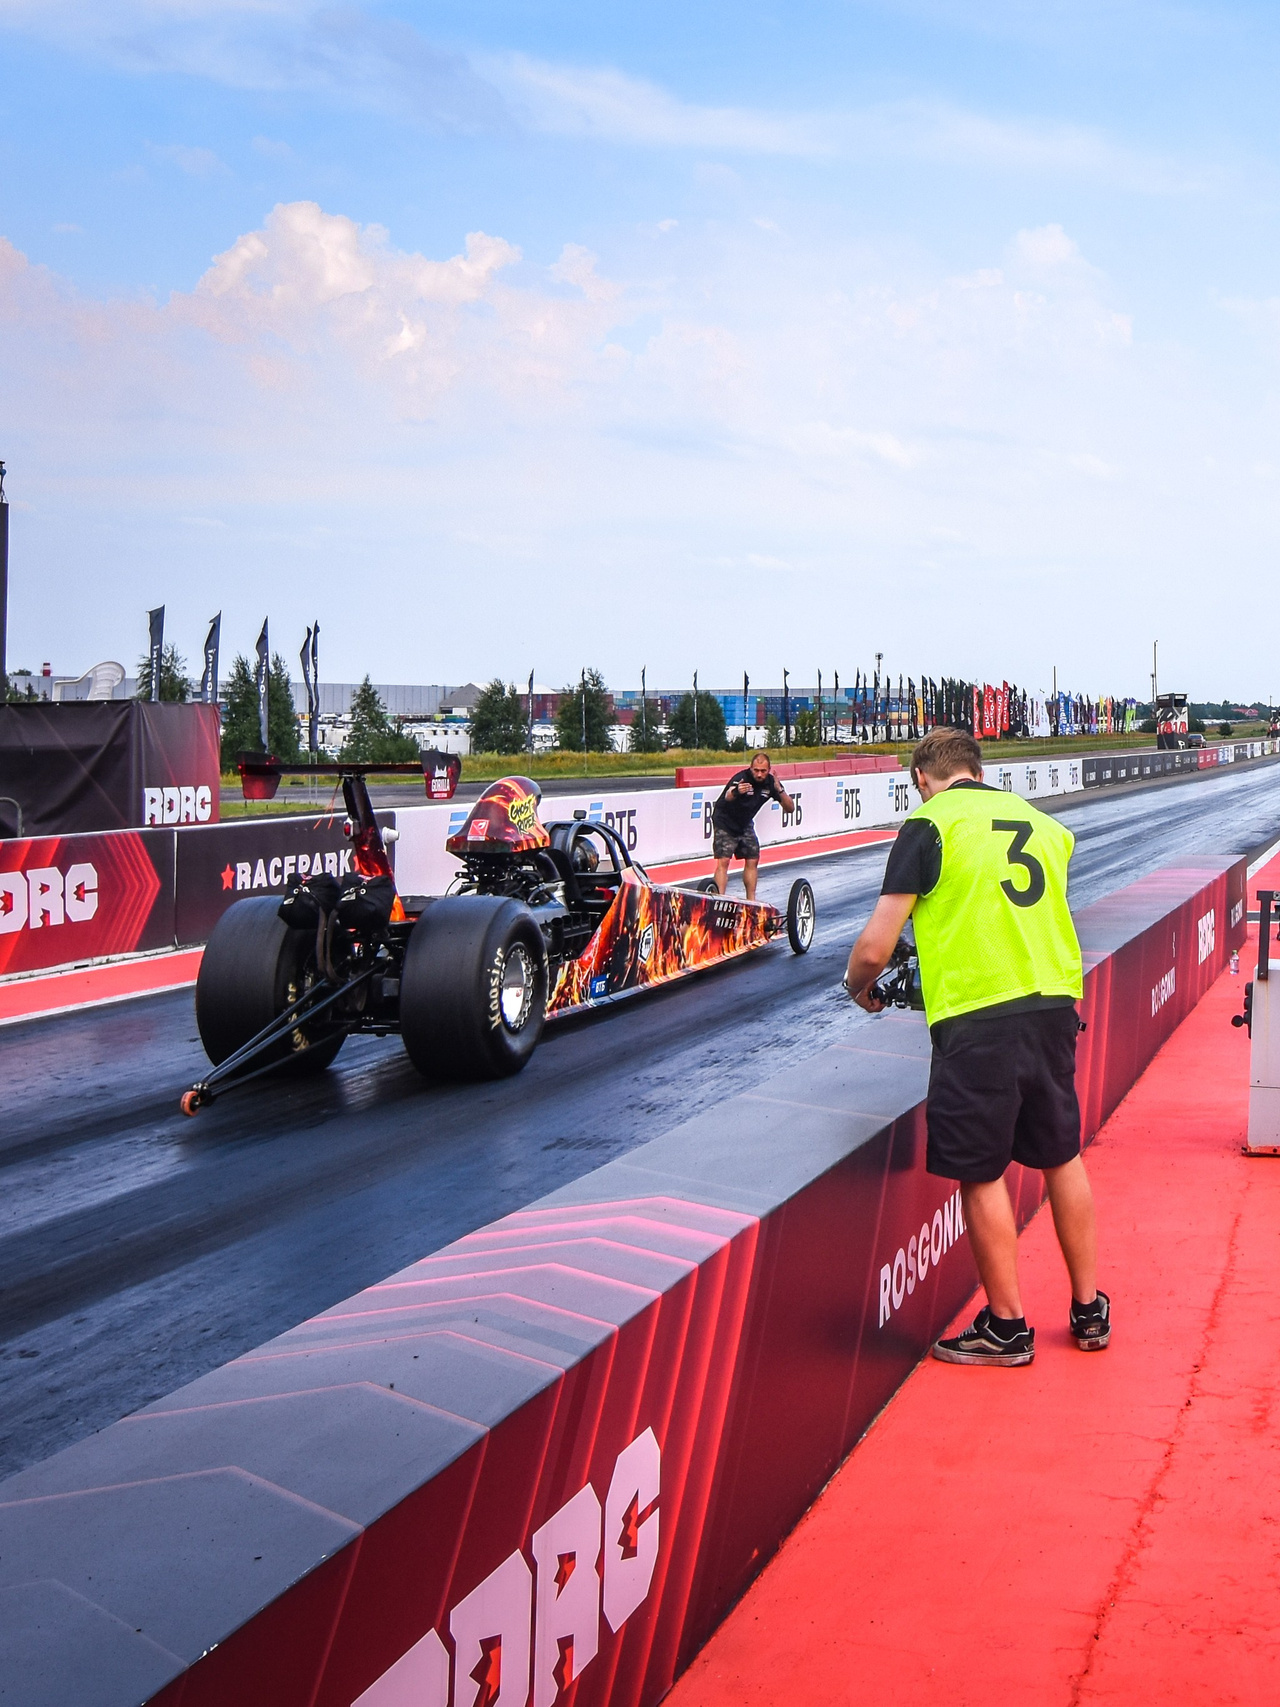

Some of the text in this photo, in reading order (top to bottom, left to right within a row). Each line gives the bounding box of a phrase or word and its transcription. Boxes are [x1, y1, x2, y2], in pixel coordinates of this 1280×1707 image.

[144, 785, 212, 825] RDRC
[844, 788, 861, 819] ВТБ
[895, 784, 909, 812] ВТБ
[236, 848, 352, 891] RACEPARK
[991, 818, 1045, 907] 3
[714, 900, 738, 913] GHOST
[1198, 908, 1215, 966] RDRC
[878, 1188, 967, 1329] ROSGONK
